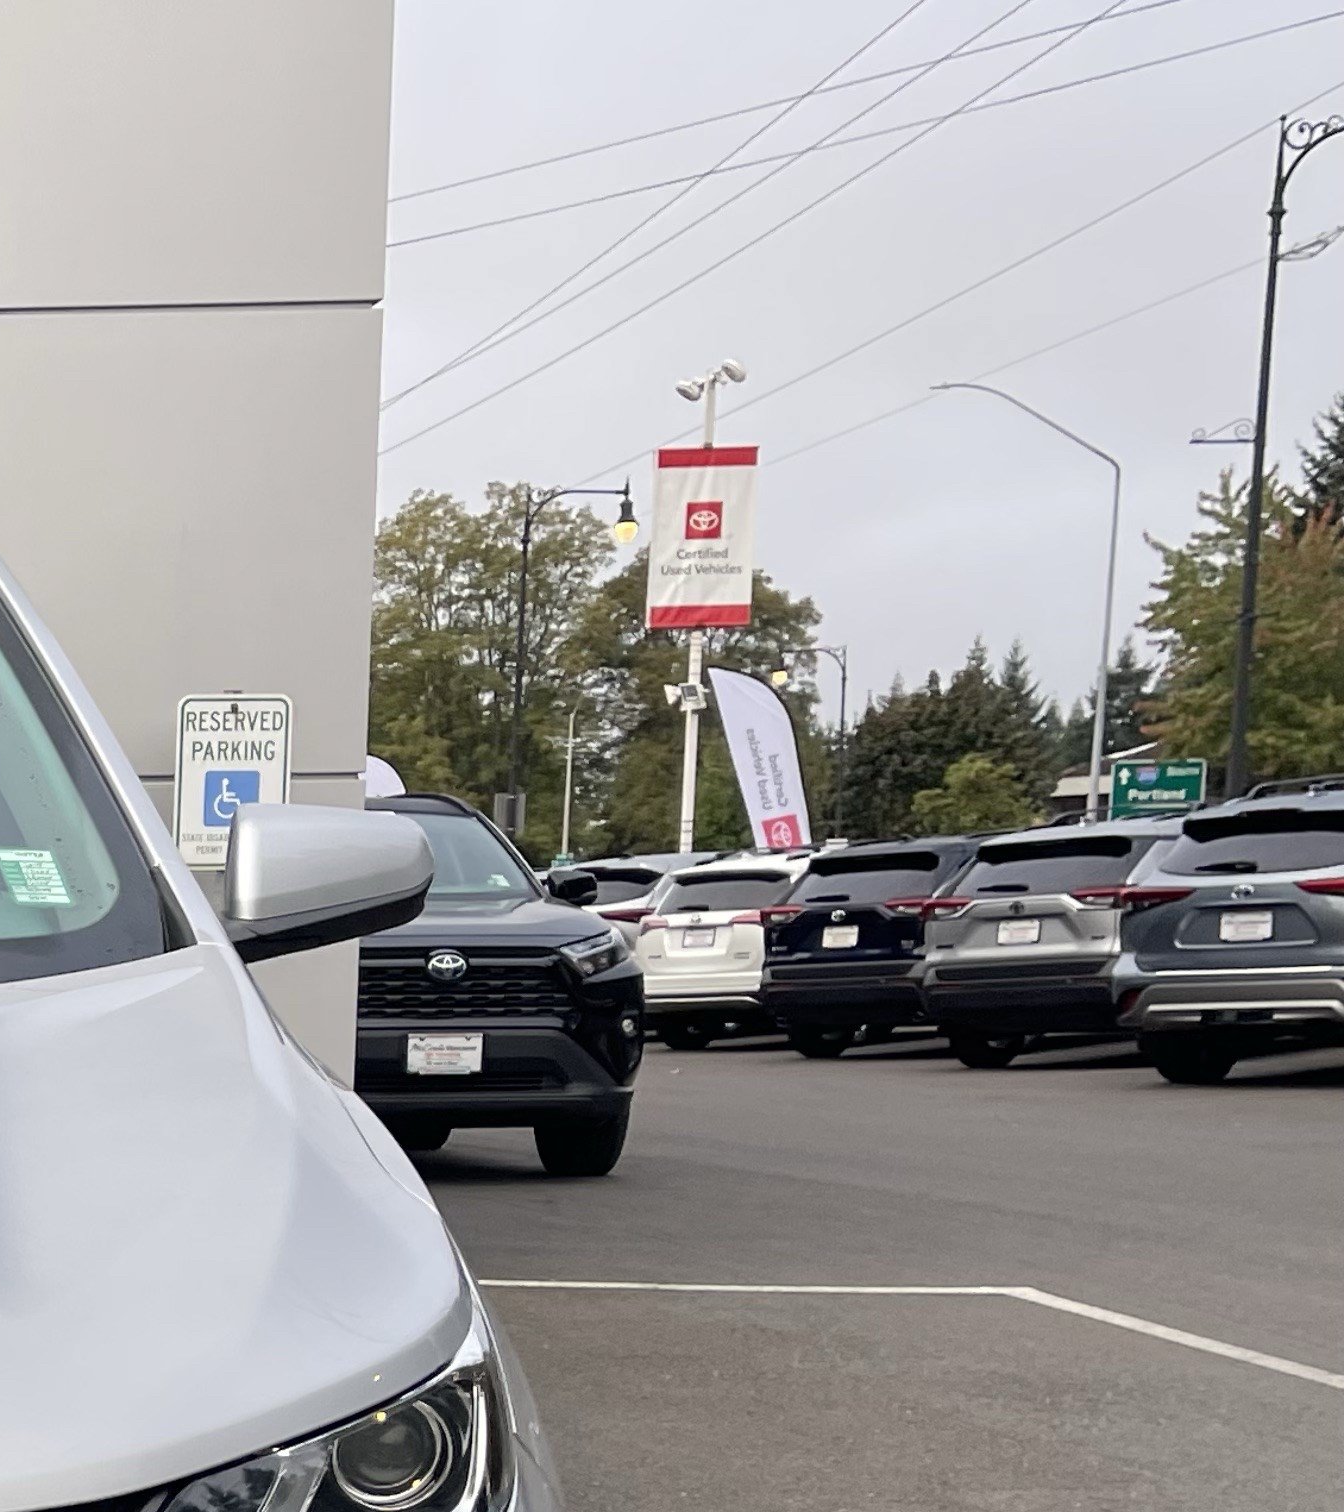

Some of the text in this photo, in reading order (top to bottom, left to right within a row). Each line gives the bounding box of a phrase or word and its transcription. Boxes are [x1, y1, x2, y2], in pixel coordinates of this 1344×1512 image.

[676, 548, 728, 559] Certified
[661, 564, 743, 575] Used Vehicles
[185, 711, 284, 732] RESERVED
[191, 740, 276, 761] PARKING
